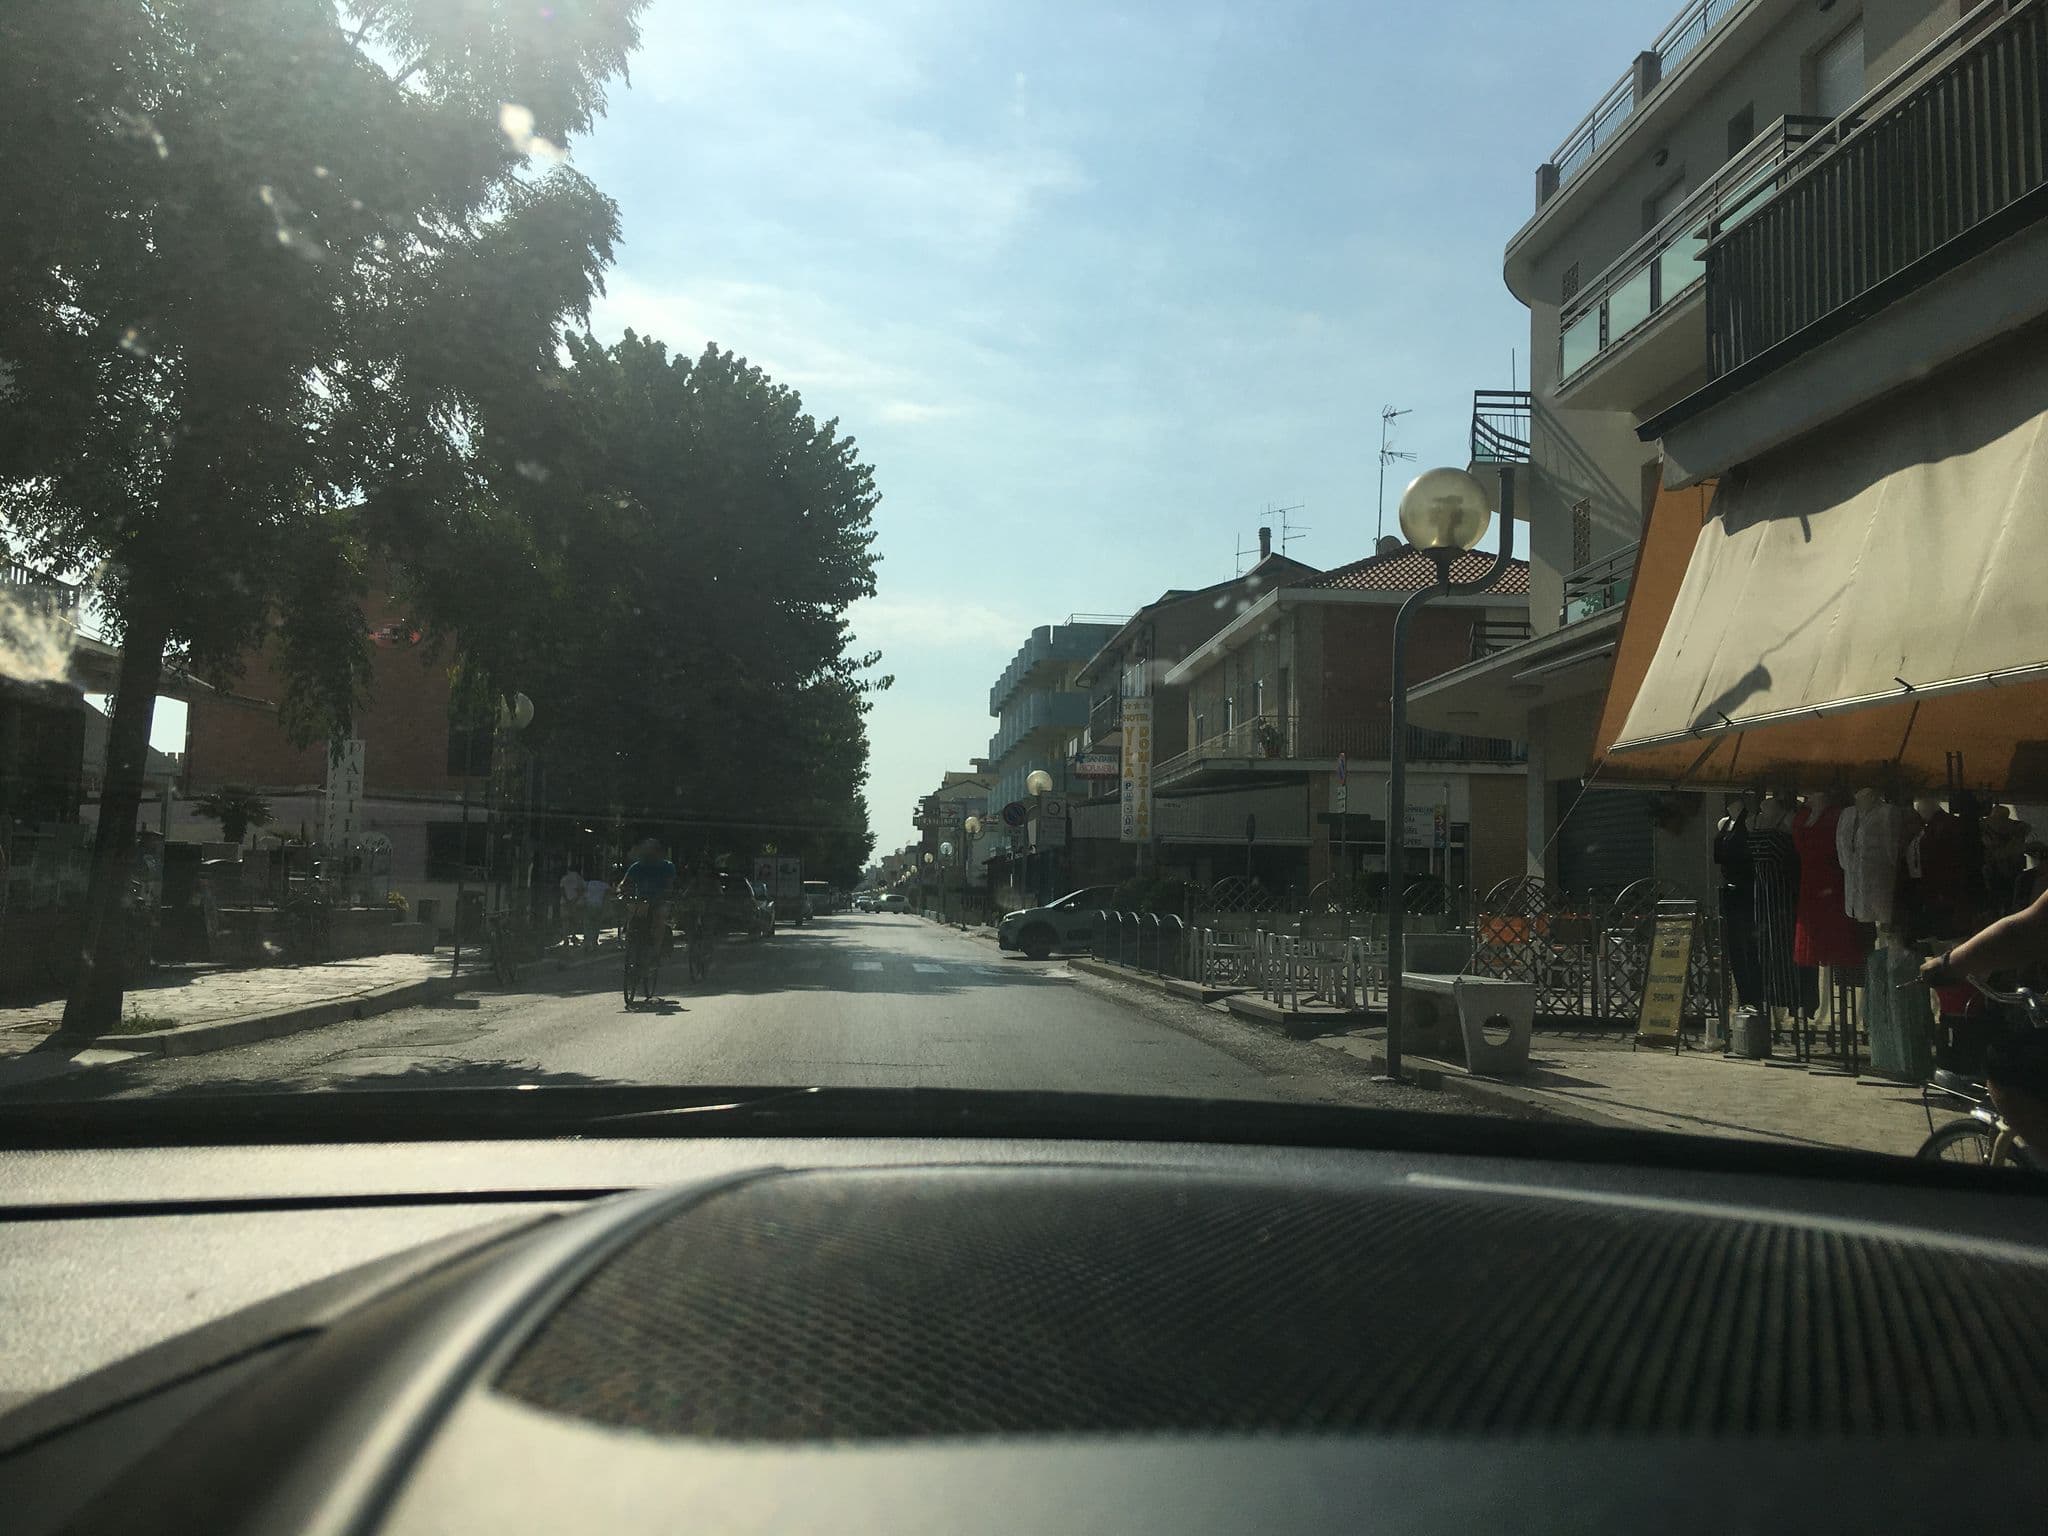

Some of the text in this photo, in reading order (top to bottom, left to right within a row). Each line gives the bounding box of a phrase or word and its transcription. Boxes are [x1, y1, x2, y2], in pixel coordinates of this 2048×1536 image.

[1122, 713, 1150, 722] HOTEL
[1124, 726, 1135, 778] VILLA
[1138, 726, 1150, 840] DOMIZIANA
